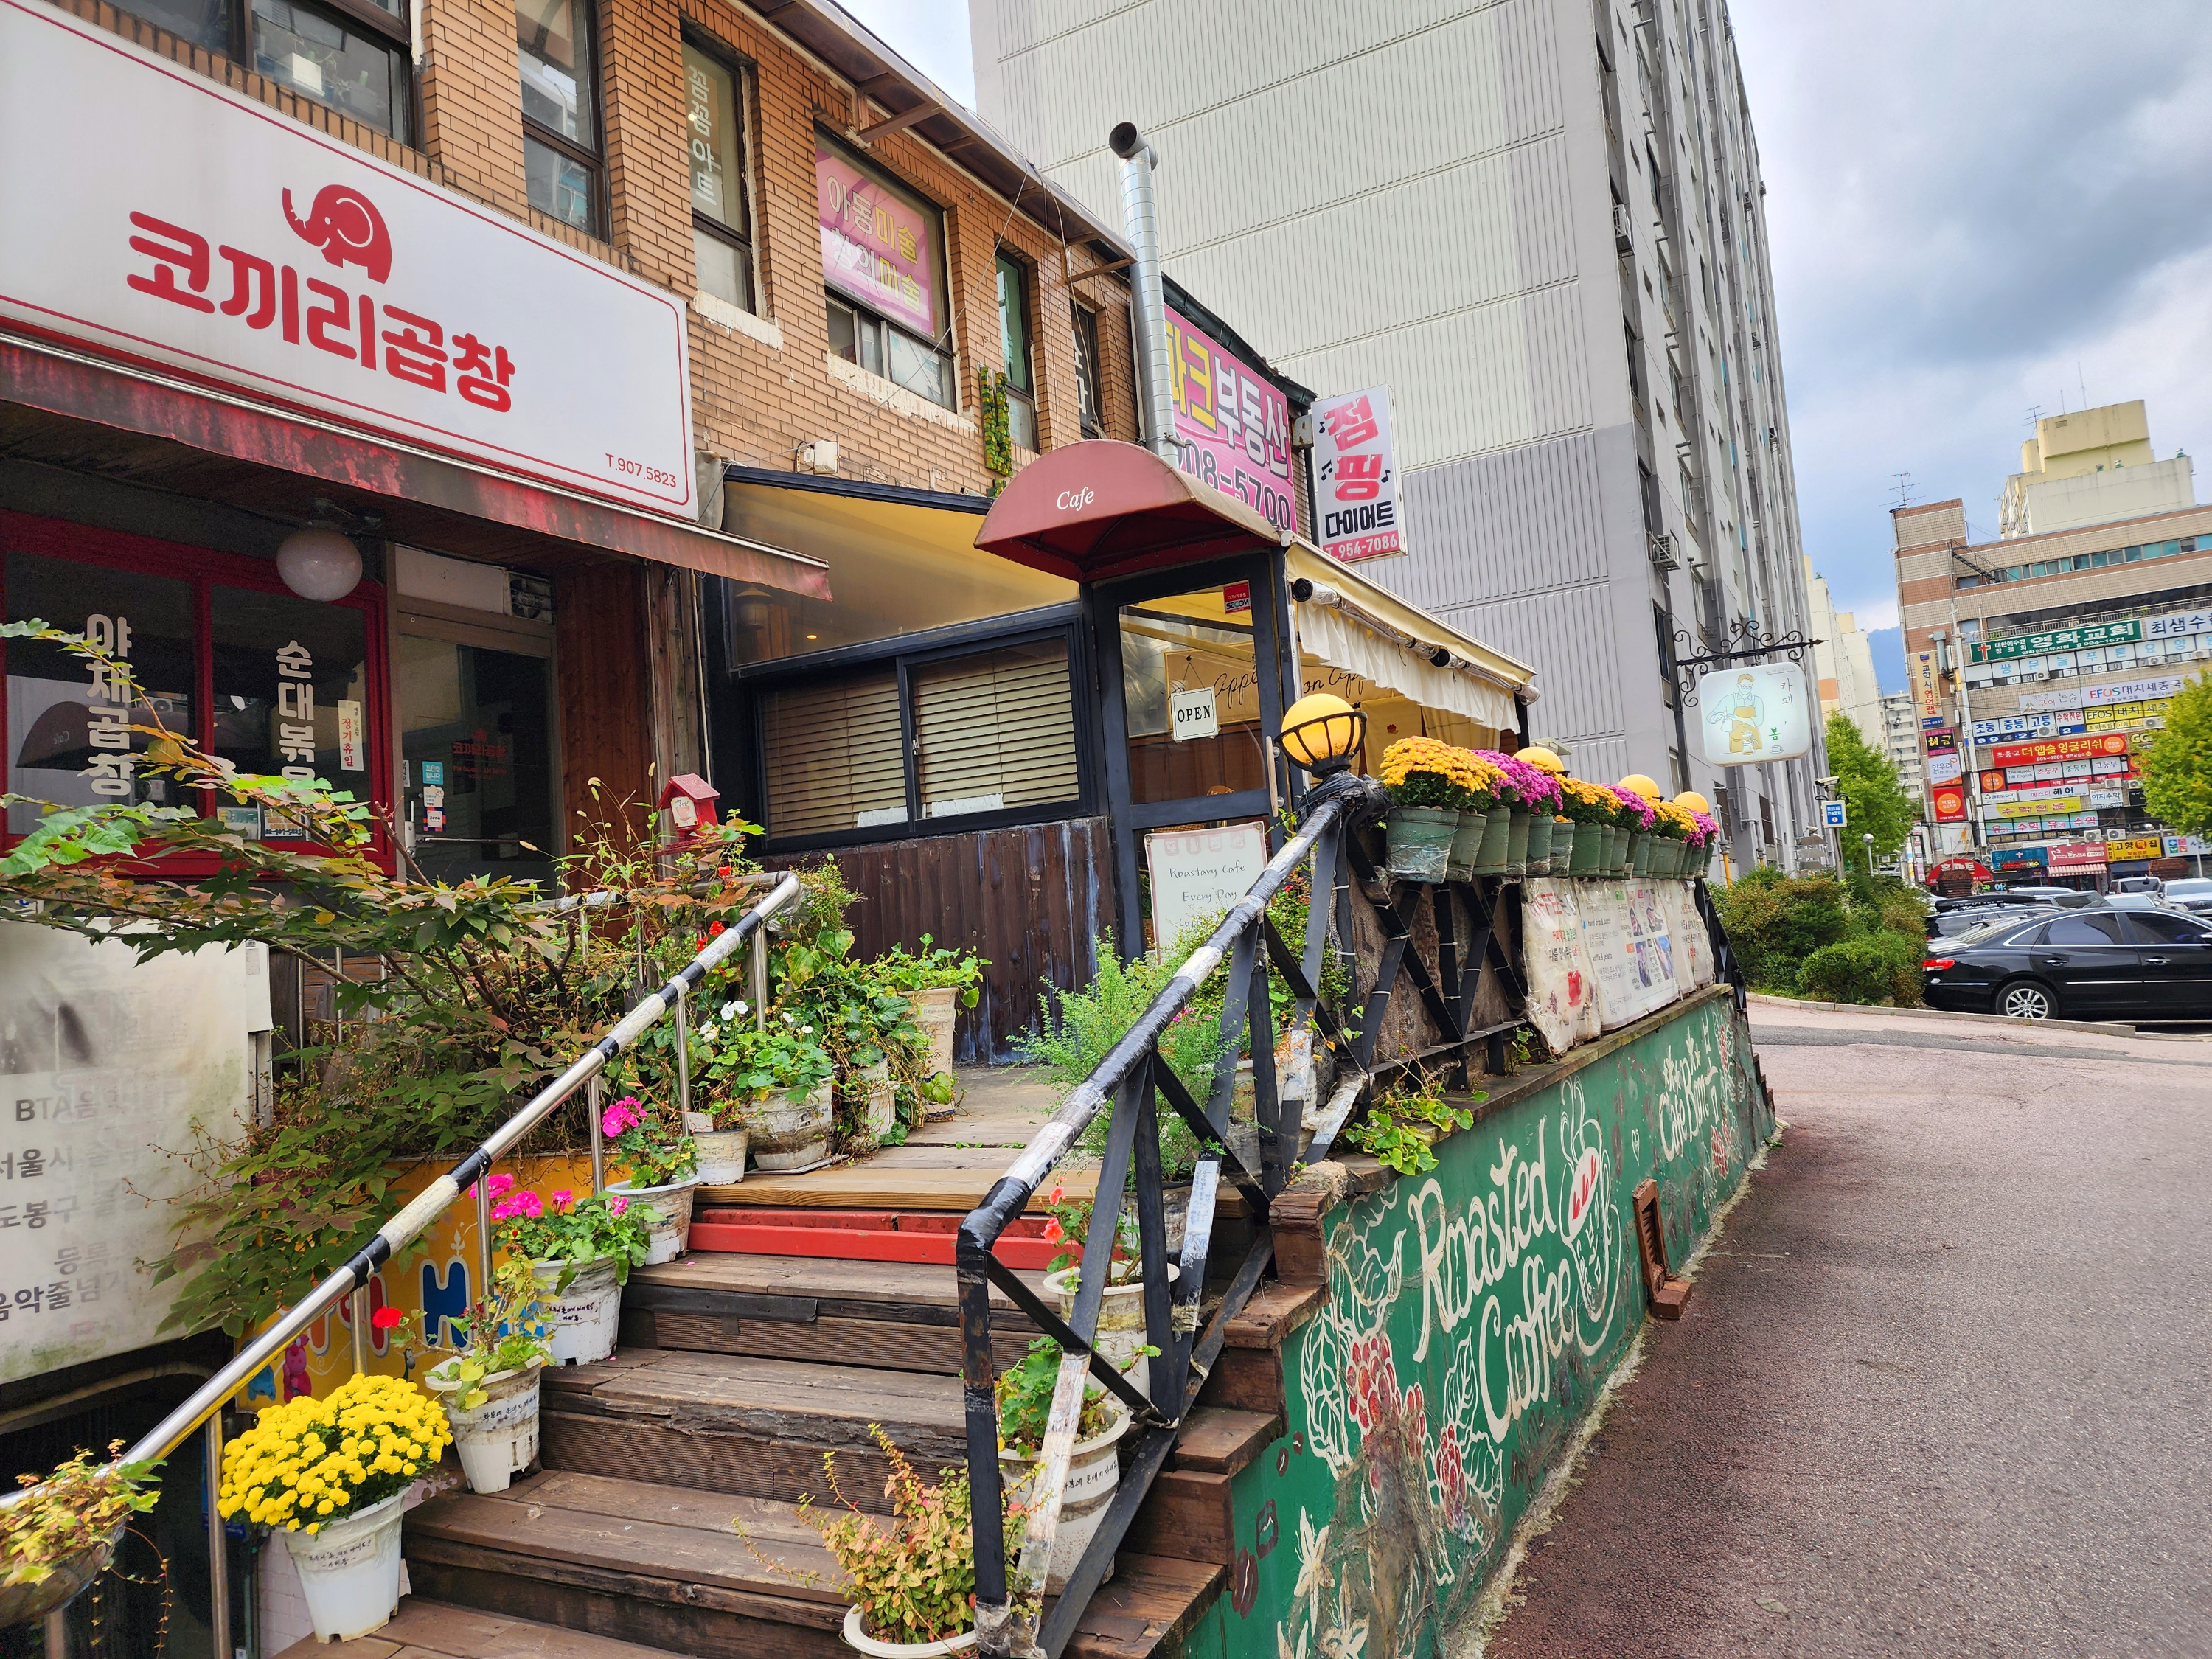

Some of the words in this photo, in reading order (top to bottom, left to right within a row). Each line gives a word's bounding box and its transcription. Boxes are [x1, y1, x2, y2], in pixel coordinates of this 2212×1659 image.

[688, 65, 717, 206] 꼼꼼아트
[826, 175, 918, 265] 아동미술
[830, 225, 921, 313] 창의미술
[127, 210, 515, 413] 코끼리곱창
[1324, 394, 1383, 501] 점핑
[605, 453, 677, 489] T.907.5823
[1178, 431, 1291, 531] 08-5700
[1057, 486, 1095, 512] Cafe
[1325, 501, 1395, 538] 다이어트
[1226, 599, 1249, 610] SECOM
[2151, 613, 2212, 634] 최샘수
[2030, 622, 2134, 648] 영화교회
[2084, 636, 2125, 646] 994-1671
[1922, 664, 1933, 689] 교학사
[1780, 678, 1793, 706] 카페
[2090, 686, 2121, 699] EFOS
[86, 613, 131, 796] 야채곱창
[1178, 704, 1211, 723] OPEN
[2039, 699, 2056, 708] 국어
[2087, 709, 2112, 720] EFOS
[2117, 705, 2140, 716] 대치
[1975, 722, 1995, 734] 초등
[2003, 718, 2024, 731] 중등
[2031, 714, 2051, 727] 고등
[2056, 712, 2082, 723] 수학전문
[341, 717, 354, 768] 정기휴일
[1769, 726, 1781, 741] 봄
[2058, 738, 2103, 753] 잉글리쉬
[1932, 762, 1952, 771] 한우리
[2037, 767, 2059, 775] 초등부
[2066, 764, 2087, 773] 중등부
[2096, 761, 2118, 769] 고등부
[2031, 790, 2051, 798] 에스더
[2052, 786, 2074, 796] 헤어
[2091, 792, 2121, 801] 이지수학
[2017, 821, 2039, 831] 수학
[2073, 816, 2096, 827] 수학
[1408, 1114, 1557, 1363] Roasted
[1479, 1254, 1576, 1444] Coffee
